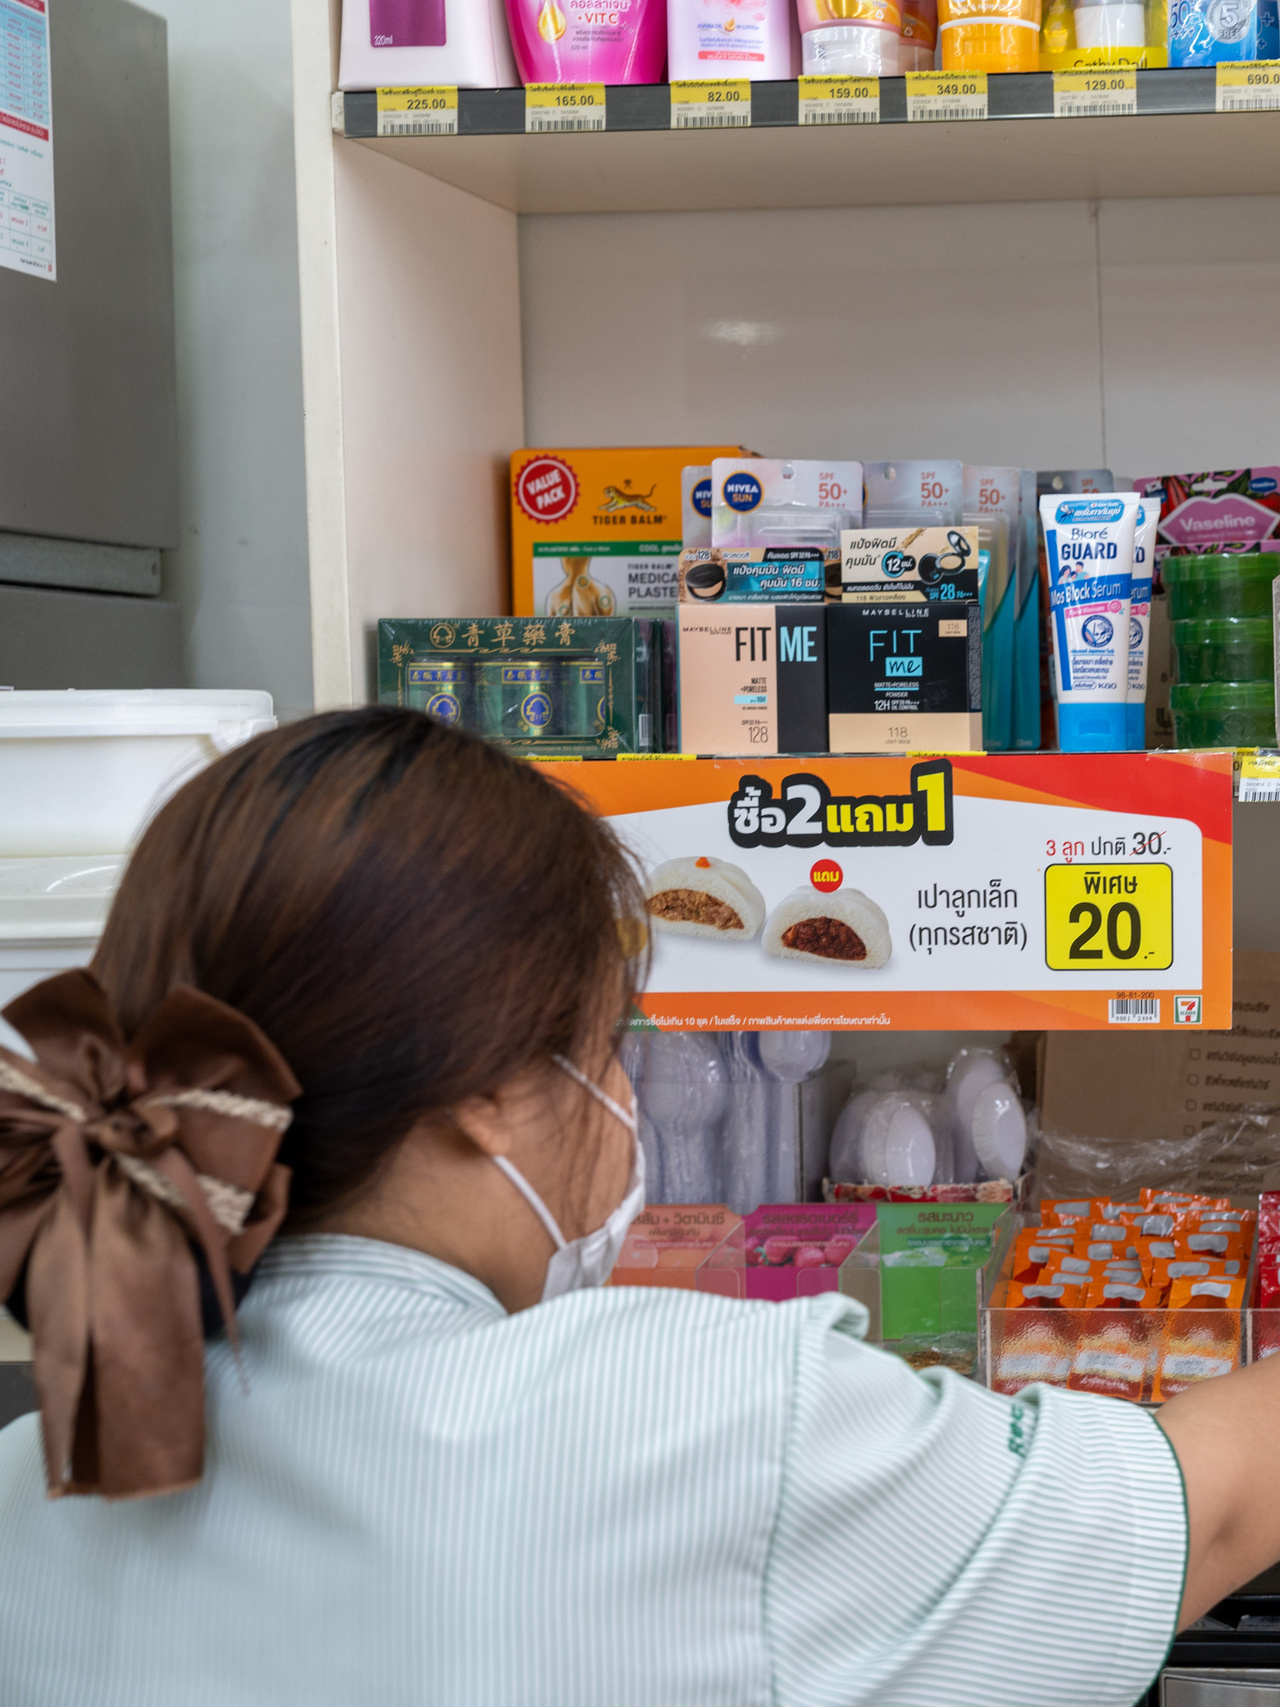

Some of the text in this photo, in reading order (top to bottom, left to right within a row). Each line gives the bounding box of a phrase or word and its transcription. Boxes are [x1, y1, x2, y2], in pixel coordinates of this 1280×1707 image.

[936, 83, 977, 95] 349.00
[1084, 79, 1125, 91] 129.00
[707, 90, 740, 102] 82.00
[829, 87, 869, 99] 159.00
[406, 98, 446, 110] 225.00
[555, 95, 594, 107] 165.00
[526, 468, 562, 494] VALUE
[819, 472, 835, 481] SPF
[920, 472, 936, 481] SPF
[980, 478, 995, 486] SPF
[727, 483, 759, 494] NIVEA
[818, 483, 849, 501] 50+
[920, 482, 949, 500] 50+
[536, 489, 566, 510] PACK
[732, 493, 753, 503] SUN
[979, 488, 1006, 506] 50+
[593, 515, 627, 525] TIGER
[1180, 514, 1256, 532] Vaseline
[1071, 526, 1108, 541] Bioré
[1061, 542, 1117, 561] GUARD
[886, 559, 901, 572] 12
[790, 577, 803, 587] 16
[939, 583, 956, 601] 28
[1066, 583, 1091, 601] Block
[1092, 580, 1121, 599] Serum
[862, 608, 930, 617] MAYBELLINE
[735, 626, 818, 663] FIT ME
[869, 629, 922, 662] FIT
[888, 659, 921, 675] me
[751, 677, 767, 685] MATTE
[874, 700, 891, 711] 12H
[748, 726, 769, 744] 128
[888, 726, 908, 738] 118
[1046, 840, 1057, 857] 3
[1062, 839, 1085, 863] ลูก
[1091, 835, 1126, 856] ปกติ
[813, 869, 840, 884] แถม
[1083, 871, 1139, 896] พิเศษ
[917, 879, 1018, 917] เปาลูกเล็ก
[908, 922, 1028, 956] (ทุกรสชาติ)
[684, 1017, 695, 1026] 10
